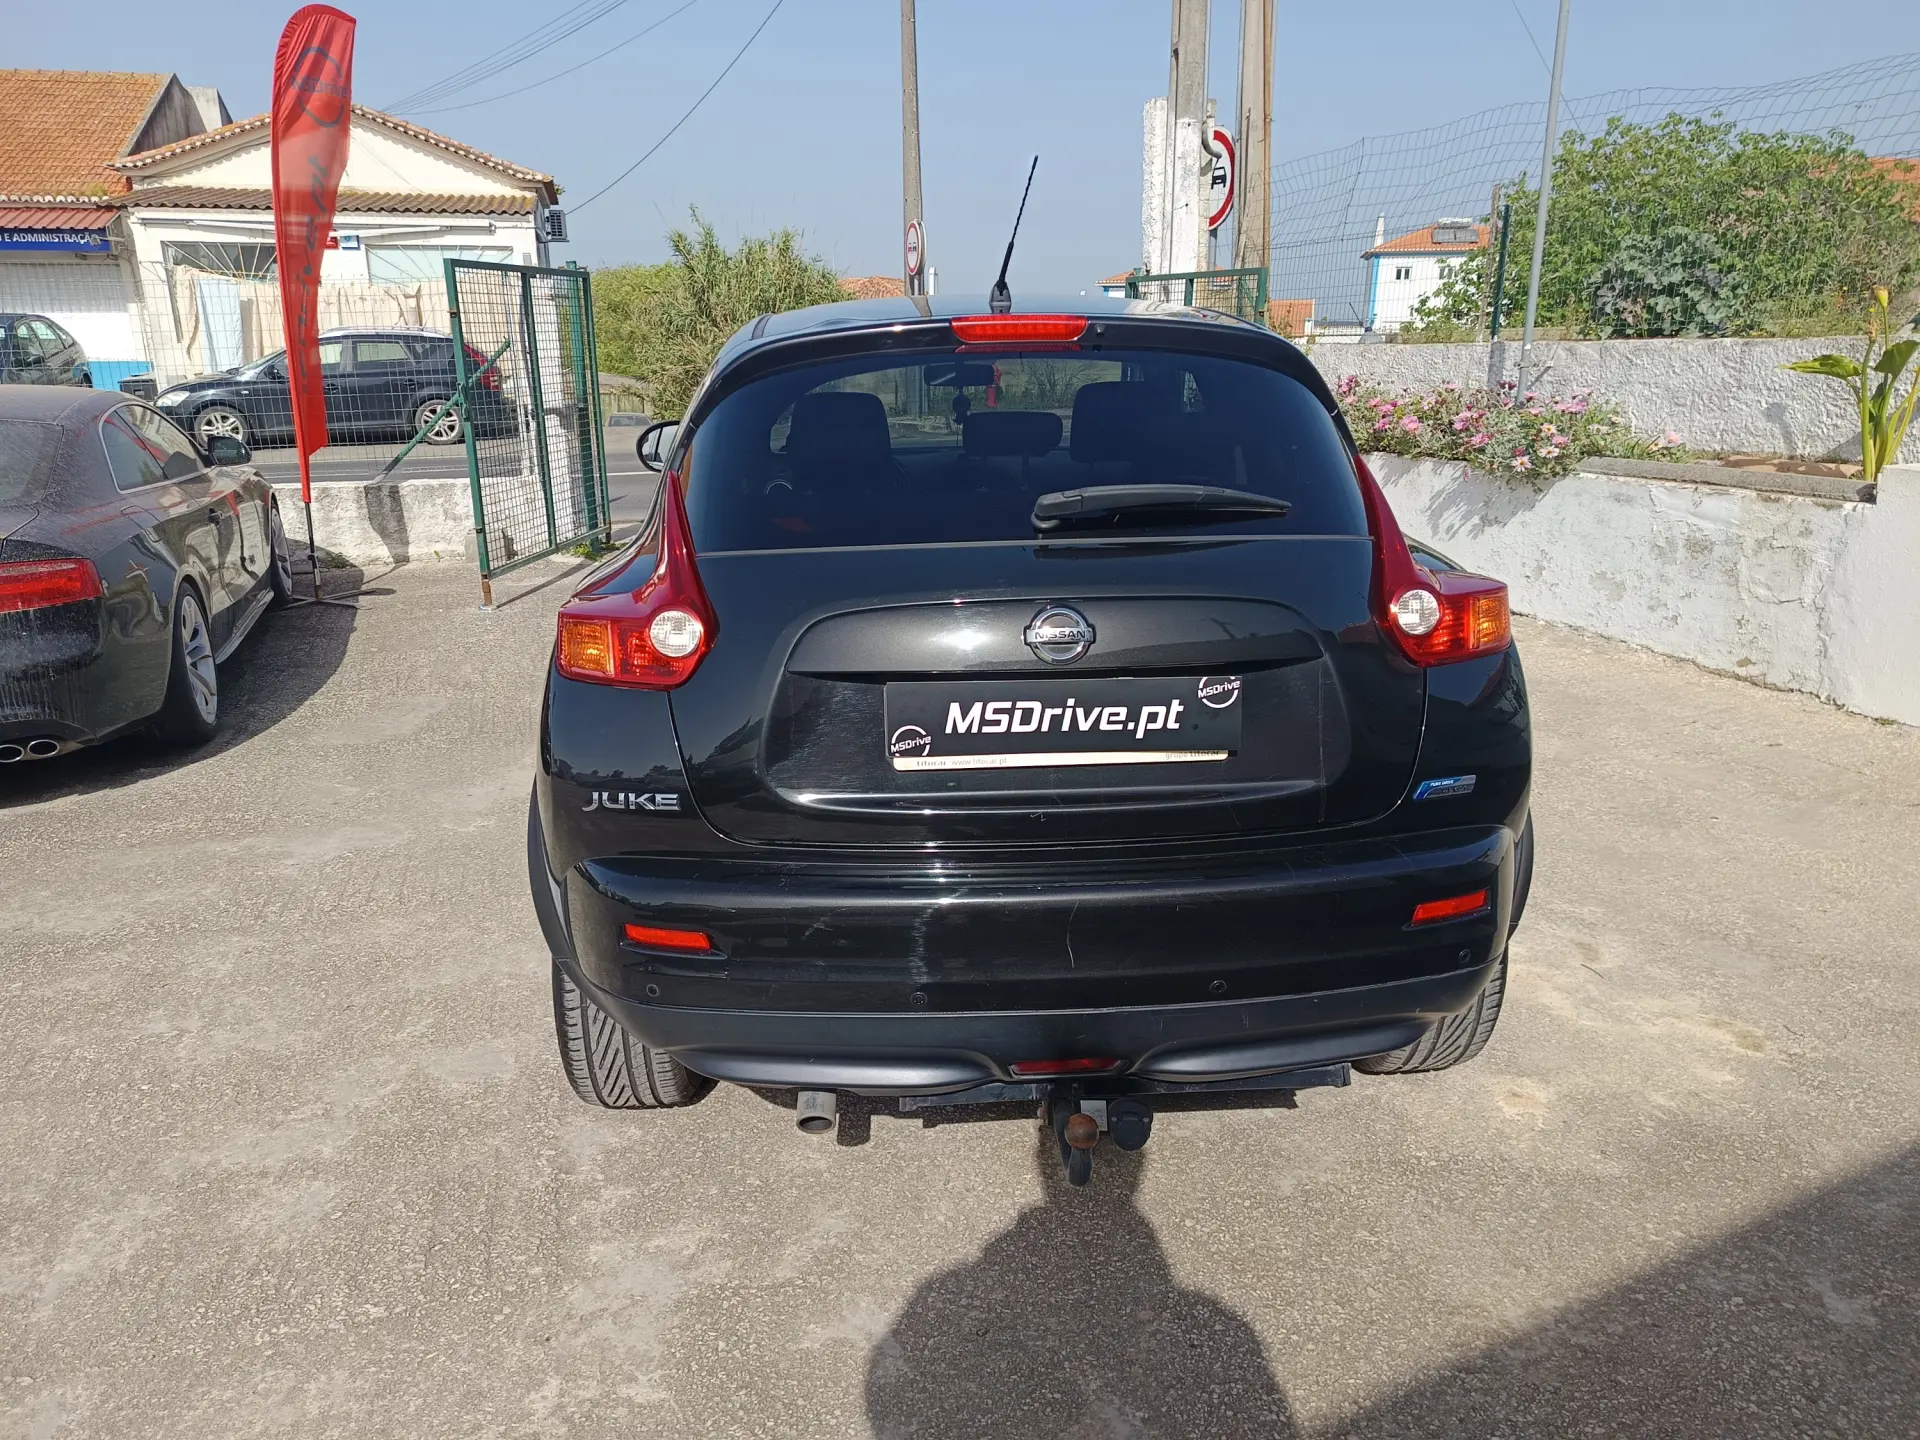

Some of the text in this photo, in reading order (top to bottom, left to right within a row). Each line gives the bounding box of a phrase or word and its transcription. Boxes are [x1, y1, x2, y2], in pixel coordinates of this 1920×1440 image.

[4, 233, 11, 242] E
[1035, 630, 1086, 640] NISSAN
[1198, 680, 1240, 698] MSDrive
[945, 698, 1184, 739] MSDrive.pt
[891, 735, 931, 753] MSDrive
[581, 791, 680, 812] JUKE
